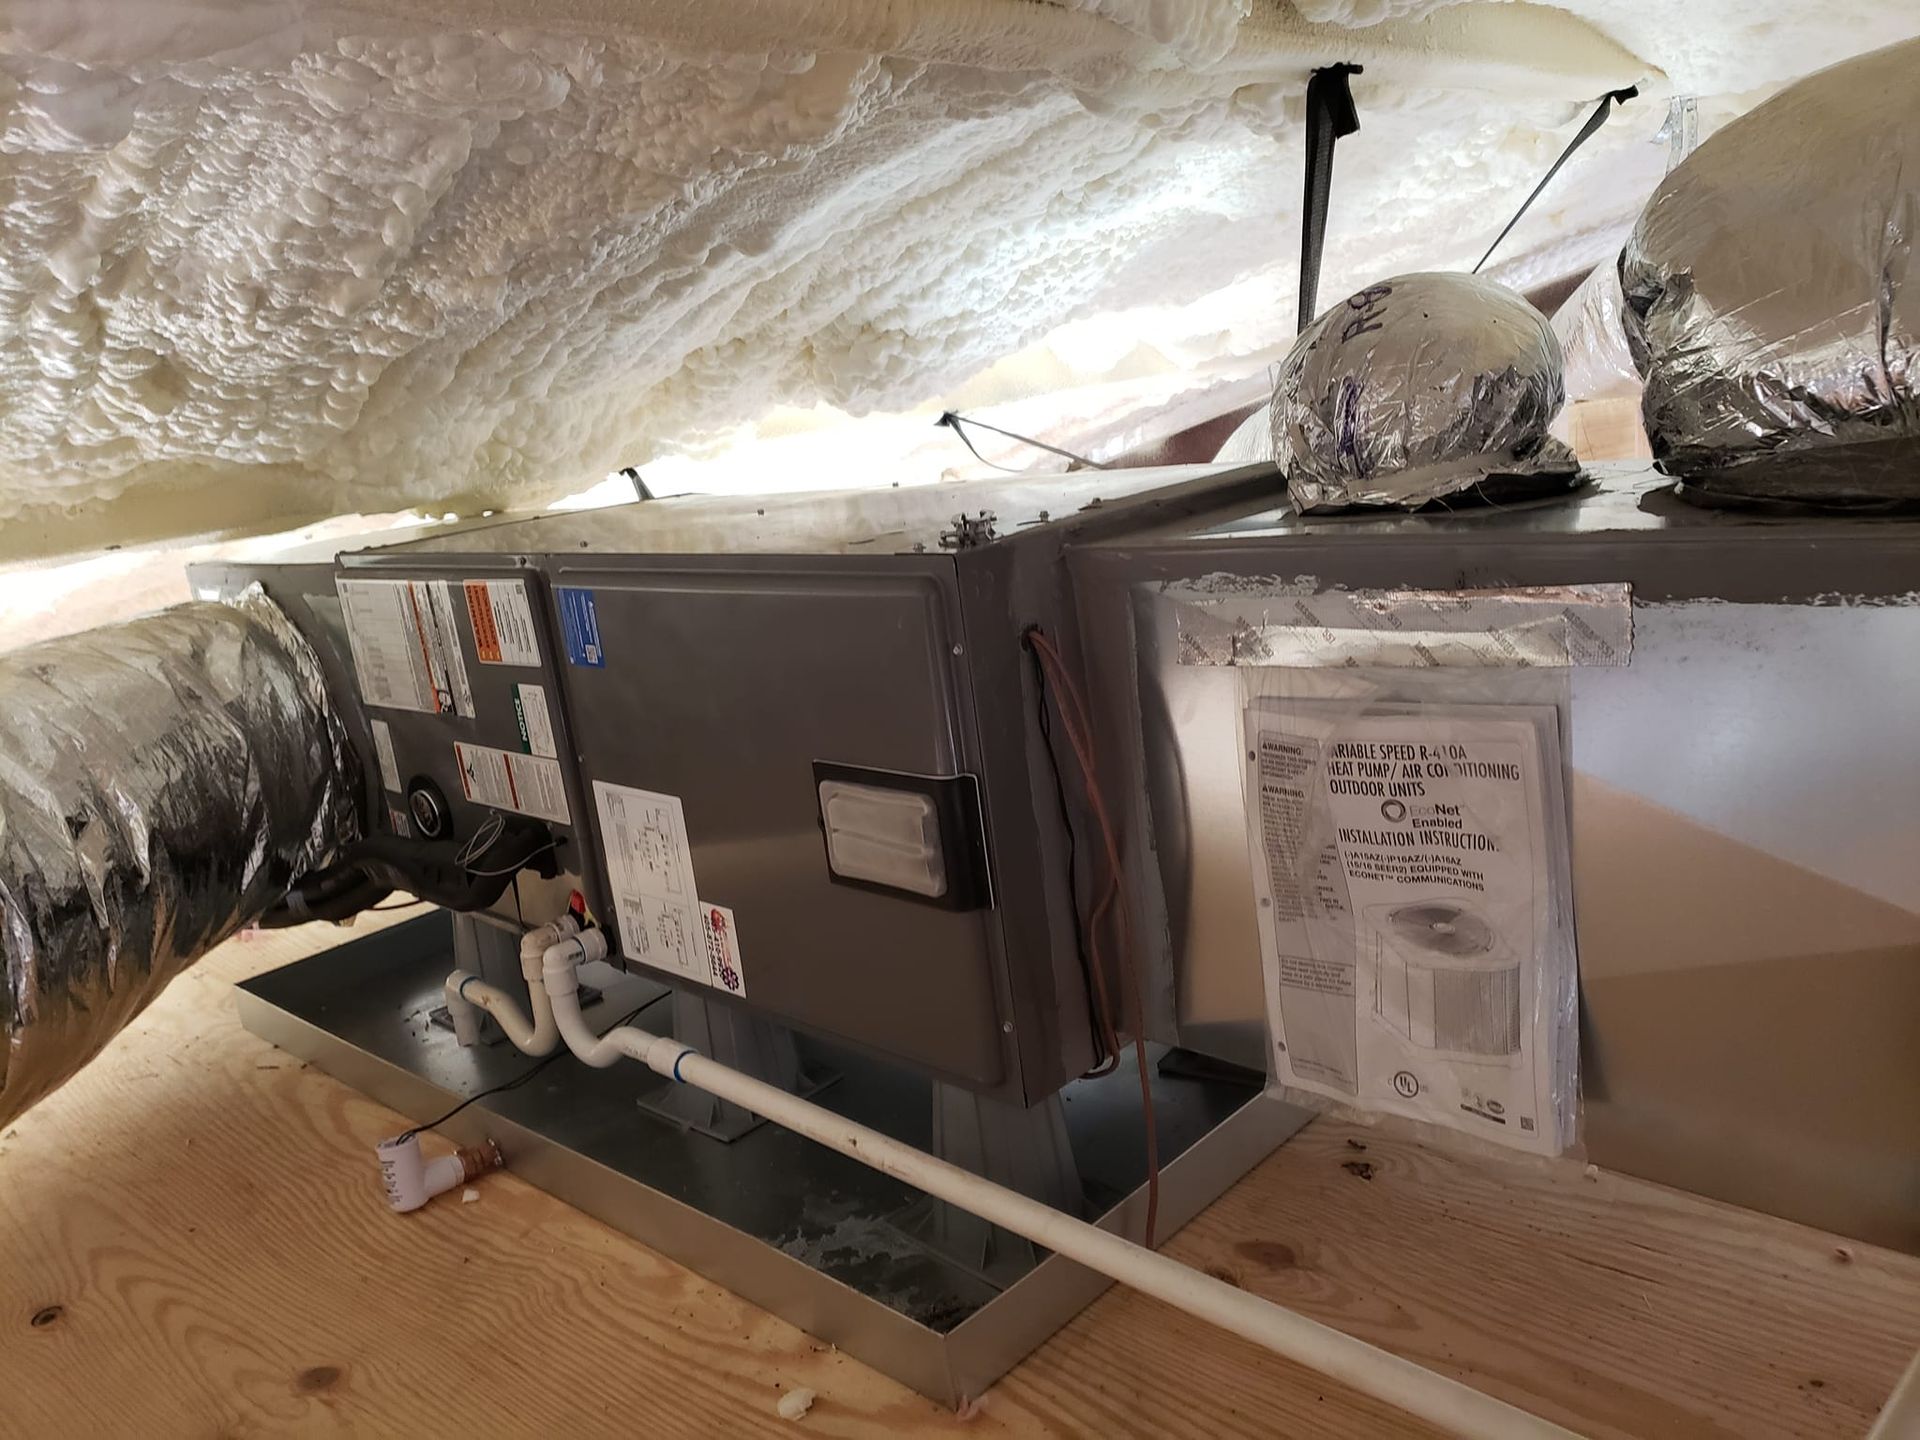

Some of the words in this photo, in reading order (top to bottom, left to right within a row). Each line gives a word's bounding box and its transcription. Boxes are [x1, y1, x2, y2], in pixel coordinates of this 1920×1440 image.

[465, 584, 483, 648] WARNING
[514, 697, 528, 742] NOTICE
[1331, 743, 1376, 760] ARIABLE
[1379, 744, 1415, 761] SPEED
[1327, 761, 1354, 777] HEAT
[1402, 763, 1423, 778] AIR
[1330, 779, 1385, 797] OUTDOOR
[1388, 781, 1425, 797] UNITS
[1412, 818, 1462, 829] Enabled
[1338, 828, 1415, 847] INSTALLATION
[1419, 830, 1500, 852] INSTRUCTION
[1410, 863, 1459, 876] EQUIPPED
[1460, 868, 1484, 881] WITH
[1397, 876, 1485, 891] COMMUNICATIONS
